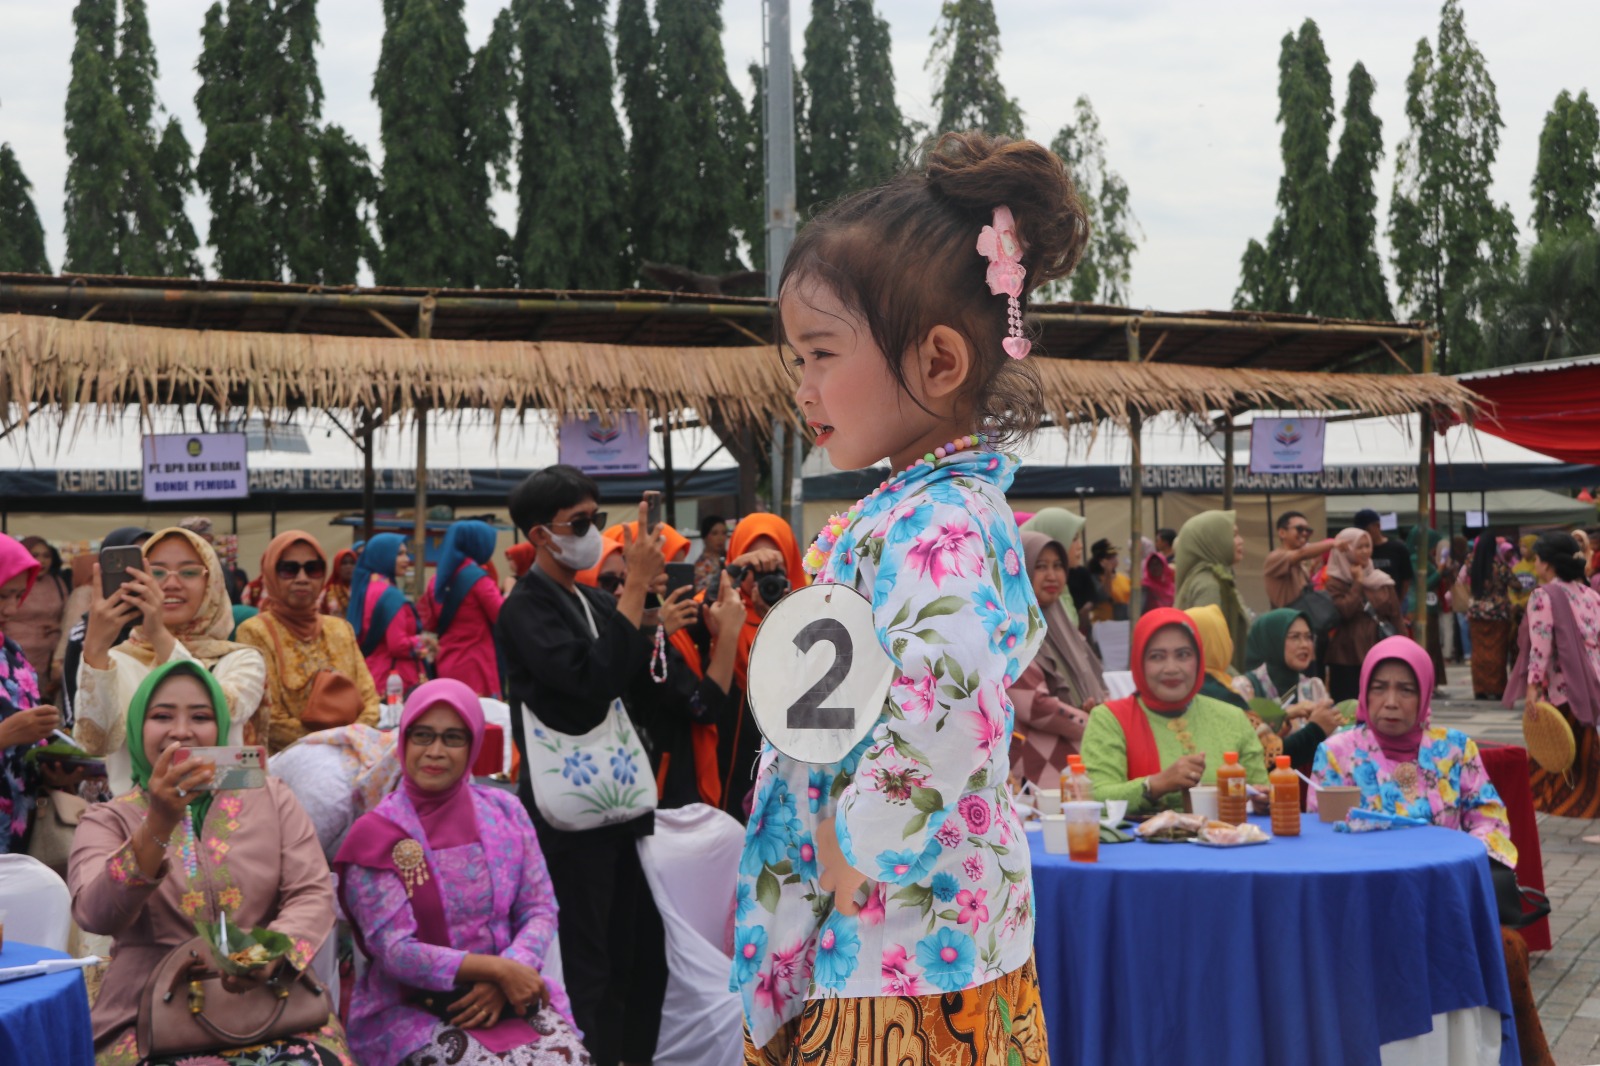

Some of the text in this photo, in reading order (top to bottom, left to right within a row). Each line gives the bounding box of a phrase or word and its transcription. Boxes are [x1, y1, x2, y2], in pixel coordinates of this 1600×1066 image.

[210, 461, 241, 472] BLORA
[1119, 465, 1203, 489] KENTERIAN
[1206, 465, 1294, 490] PEDAGANGAN
[1357, 465, 1419, 488] INDONESIA
[57, 468, 474, 491] KEMENTE ANGAN REPUBK INDNESIA
[194, 479, 237, 491] PEMUDA
[787, 618, 855, 729] 2
